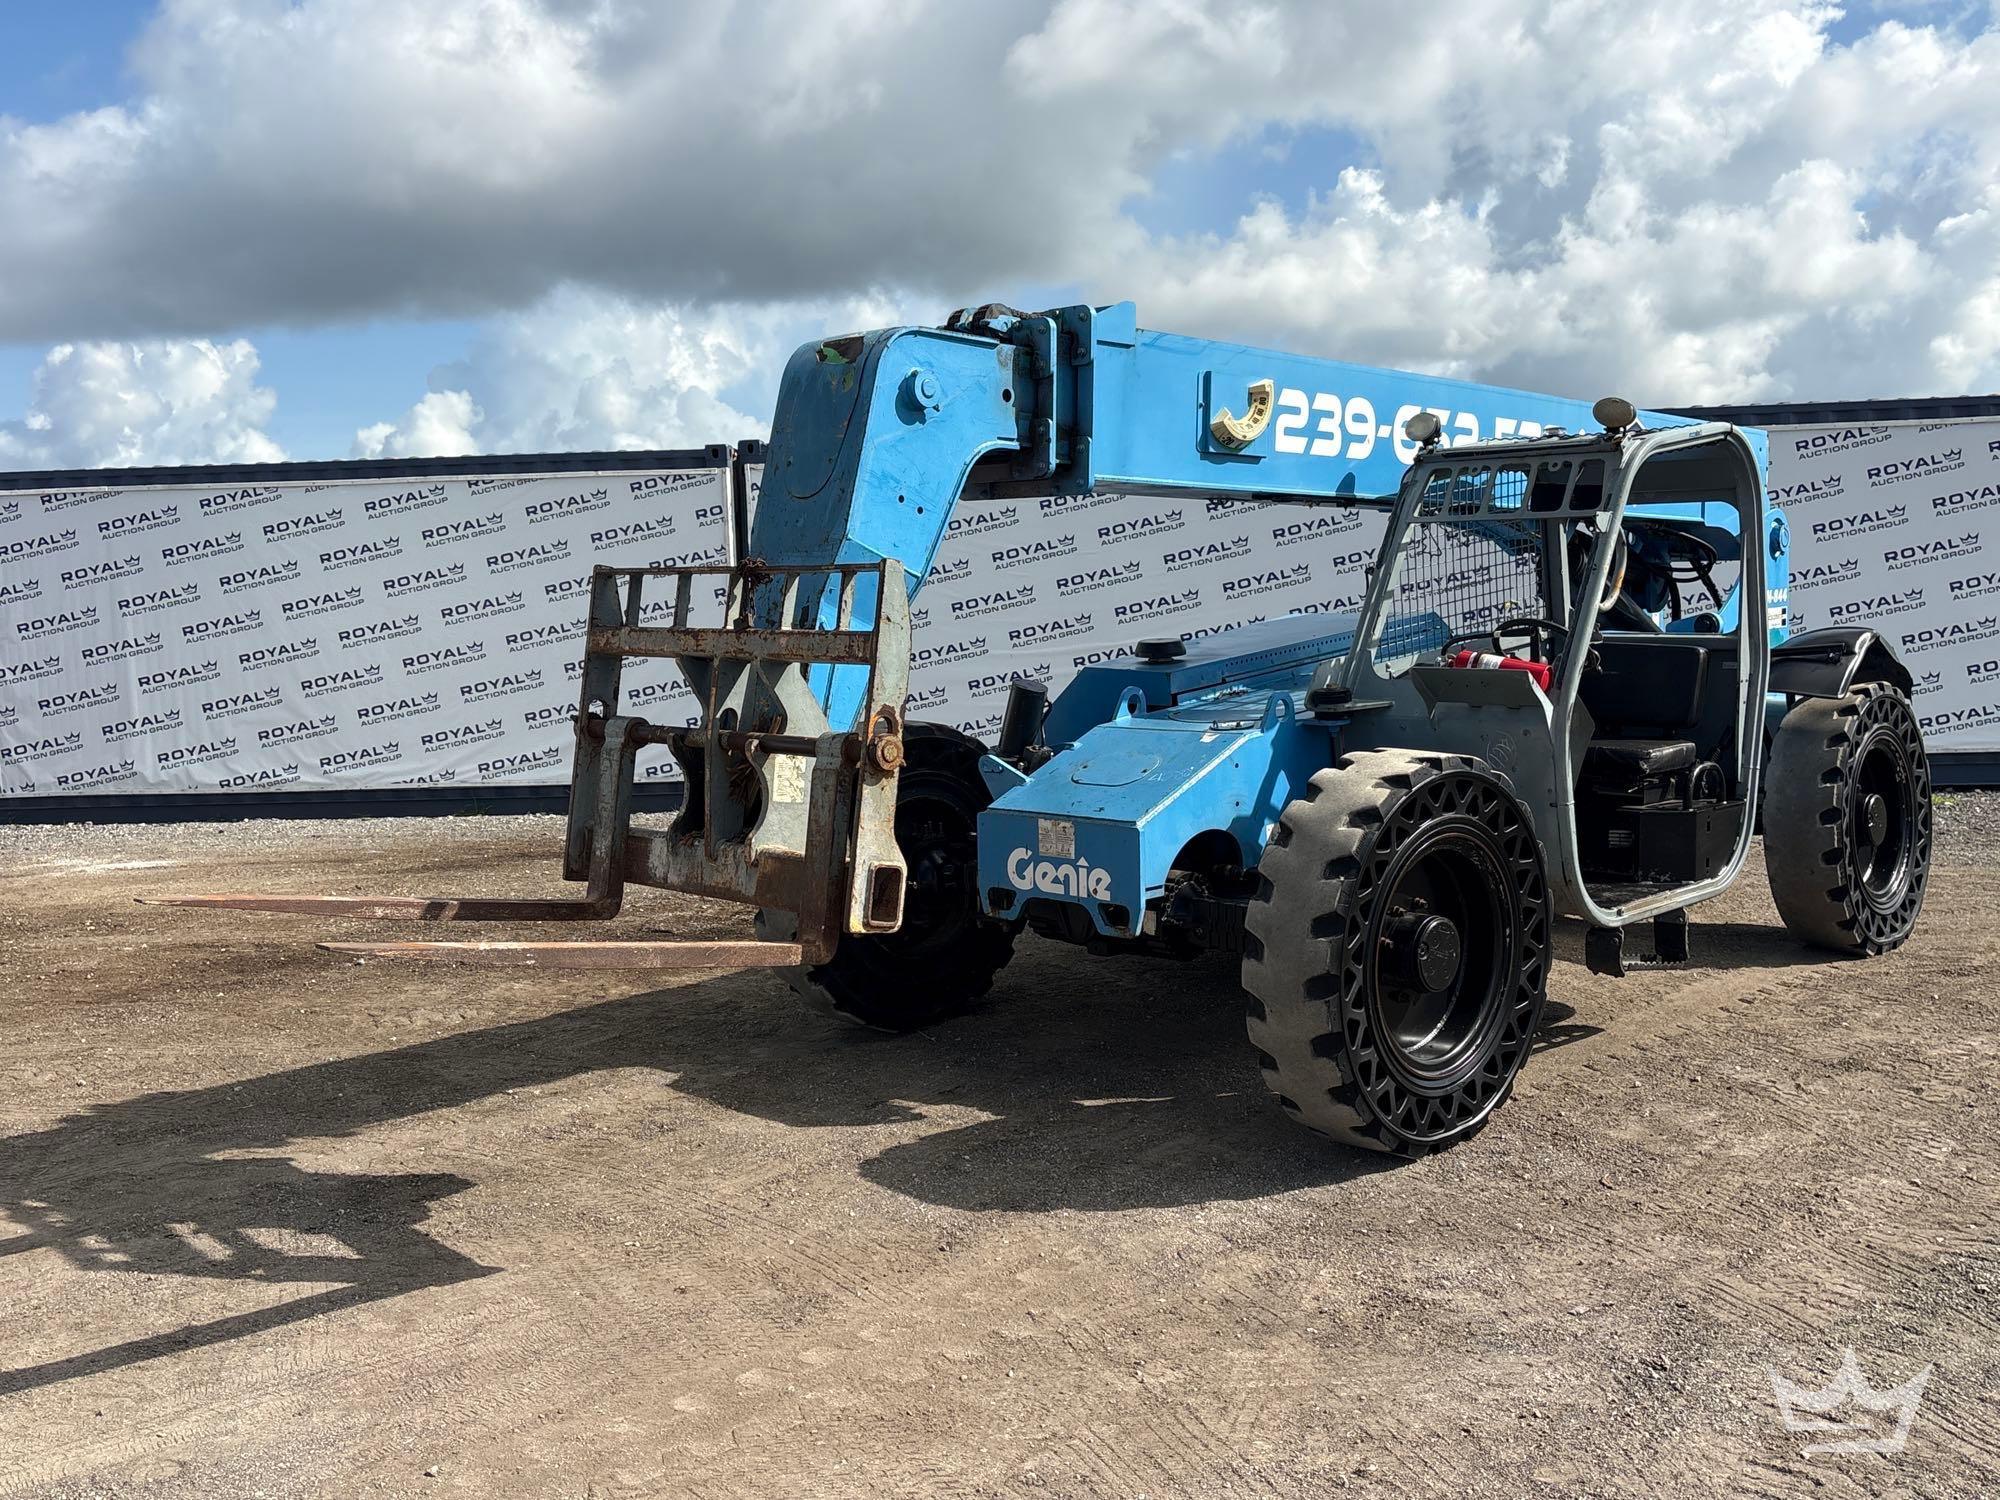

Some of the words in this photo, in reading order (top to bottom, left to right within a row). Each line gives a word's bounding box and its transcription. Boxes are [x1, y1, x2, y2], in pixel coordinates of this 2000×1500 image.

[1867, 455, 1943, 480] ROYAL
[1871, 471, 1922, 488] AUCTION
[1924, 462, 1965, 476] GROUP
[364, 490, 429, 512] ROYAL
[368, 505, 412, 520] AUCTION
[413, 497, 448, 509] GROUP
[525, 494, 591, 517] ROYAL
[98, 511, 162, 533] ROYAL
[529, 510, 574, 524] AUCTION
[575, 501, 610, 514] GROUP
[1812, 511, 1887, 535] ROYAL
[102, 526, 145, 540] AUCTION
[147, 518, 181, 530] GROUP
[262, 514, 327, 536] ROYAL
[267, 529, 310, 544] AUCTION
[311, 521, 345, 533] GROUP
[421, 518, 487, 541] ROYAL
[590, 521, 656, 544] ROYAL
[1097, 515, 1165, 538] ROYAL
[1101, 531, 1147, 546] AUCTION
[1149, 522, 1185, 535] GROUP
[1272, 516, 1342, 540] ROYAL
[1276, 532, 1323, 547] AUCTION
[1325, 523, 1362, 536] GROUP
[1816, 527, 1866, 543] AUCTION
[1868, 518, 1909, 532] GROUP
[426, 534, 469, 548] AUCTION
[471, 525, 506, 538] GROUP
[594, 537, 639, 551] AUCTION
[640, 528, 676, 541] GROUP
[162, 537, 226, 559] ROYAL
[166, 552, 209, 567] AUCTION
[210, 544, 244, 556] GROUP
[319, 542, 384, 564] ROYAL
[486, 545, 552, 567] ROYAL
[991, 540, 1058, 563] ROYAL
[995, 556, 1040, 570] AUCTION
[1042, 547, 1077, 560] GROUP
[1163, 542, 1232, 565] ROYAL
[1884, 539, 1960, 563] ROYAL
[1888, 555, 1939, 571] AUCTION
[1941, 546, 1982, 560] GROUP
[60, 560, 125, 583] ROYAL
[323, 557, 367, 572] AUCTION
[368, 549, 403, 561] GROUP
[490, 560, 534, 575] AUCTION
[536, 552, 571, 564] GROUP
[1167, 557, 1213, 573] AUCTION
[1215, 548, 1251, 561] GROUP
[65, 576, 108, 590] AUCTION
[109, 567, 143, 580] GROUP
[219, 565, 282, 587] ROYAL
[223, 580, 265, 595] AUCTION
[267, 572, 301, 584] GROUP
[383, 568, 448, 591] ROYAL
[387, 584, 431, 598] AUCTION
[432, 576, 467, 588] GROUP
[1056, 566, 1123, 589] ROYAL
[1060, 582, 1105, 597] AUCTION
[1107, 574, 1143, 586] GROUP
[1222, 570, 1292, 593] ROYAL
[118, 588, 182, 610] ROYAL
[1226, 585, 1272, 601] AUCTION
[1274, 576, 1311, 590] GROUP
[122, 603, 165, 618] AUCTION
[167, 595, 201, 608] GROUP
[281, 592, 346, 614] ROYAL
[286, 607, 328, 621] AUCTION
[330, 599, 364, 611] GROUP
[441, 597, 506, 619] ROYAL
[951, 591, 1017, 613] ROYAL
[955, 606, 999, 620] AUCTION
[1001, 598, 1036, 610] GROUP
[1114, 595, 1182, 617] ROYAL
[1829, 594, 1904, 618] ROYAL
[17, 612, 81, 634] ROYAL
[445, 612, 489, 626] AUCTION
[490, 604, 525, 616] GROUP
[1118, 610, 1164, 625] AUCTION
[1165, 602, 1202, 614] GROUP
[1833, 610, 1884, 626] AUCTION
[1886, 602, 1926, 615] GROUP
[22, 627, 64, 641] AUCTION
[66, 618, 100, 631] GROUP
[182, 615, 245, 637] ROYAL
[186, 630, 228, 644] AUCTION
[230, 622, 264, 634] GROUP
[338, 620, 403, 642] ROYAL
[1008, 619, 1075, 641] ROYAL
[1901, 622, 1978, 646] ROYAL
[342, 635, 386, 649] AUCTION
[387, 627, 422, 639] GROUP
[1012, 634, 1057, 649] AUCTION
[1059, 626, 1094, 638] GROUP
[1905, 639, 1956, 654] AUCTION
[1959, 630, 2000, 643] GROUP
[81, 638, 145, 660] ROYAL
[86, 653, 128, 667] AUCTION
[130, 645, 163, 657] GROUP
[239, 643, 301, 664] ROYAL
[402, 646, 467, 668] ROYAL
[243, 658, 285, 672] AUCTION
[286, 650, 319, 662] GROUP
[406, 662, 450, 676] AUCTION
[452, 654, 486, 666] GROUP
[138, 665, 202, 687] ROYAL
[142, 680, 185, 695] AUCTION
[187, 672, 221, 684] GROUP
[300, 669, 364, 691] ROYAL
[460, 674, 525, 696] ROYAL
[305, 684, 347, 699] AUCTION
[349, 676, 383, 689] GROUP
[464, 690, 508, 704] AUCTION
[510, 682, 544, 694] GROUP
[38, 688, 102, 710] ROYAL
[43, 703, 85, 718] AUCTION
[87, 695, 120, 707] GROUP
[202, 692, 265, 714] ROYAL
[206, 707, 248, 721] AUCTION
[250, 699, 283, 711] GROUP
[357, 697, 422, 719] ROYAL
[361, 712, 405, 727] AUCTION
[406, 704, 441, 717] GROUP
[258, 720, 320, 741] ROYAL
[262, 735, 303, 749] AUCTION
[305, 727, 338, 739] GROUP
[421, 724, 486, 746] ROYAL
[0, 737, 65, 759] ROYAL
[157, 742, 221, 764] ROYAL
[425, 739, 468, 753] AUCTION
[470, 731, 505, 743] GROUP
[4, 752, 48, 766] AUCTION
[49, 744, 84, 756] GROUP
[161, 757, 204, 771] AUCTION
[205, 749, 239, 761] GROUP
[319, 747, 383, 768] ROYAL
[323, 762, 366, 775] AUCTION
[368, 754, 402, 766] GROUP
[477, 752, 543, 773] ROYAL
[481, 767, 525, 781] AUCTION
[527, 759, 562, 771] GROUP
[1007, 847, 1111, 901] Genie
